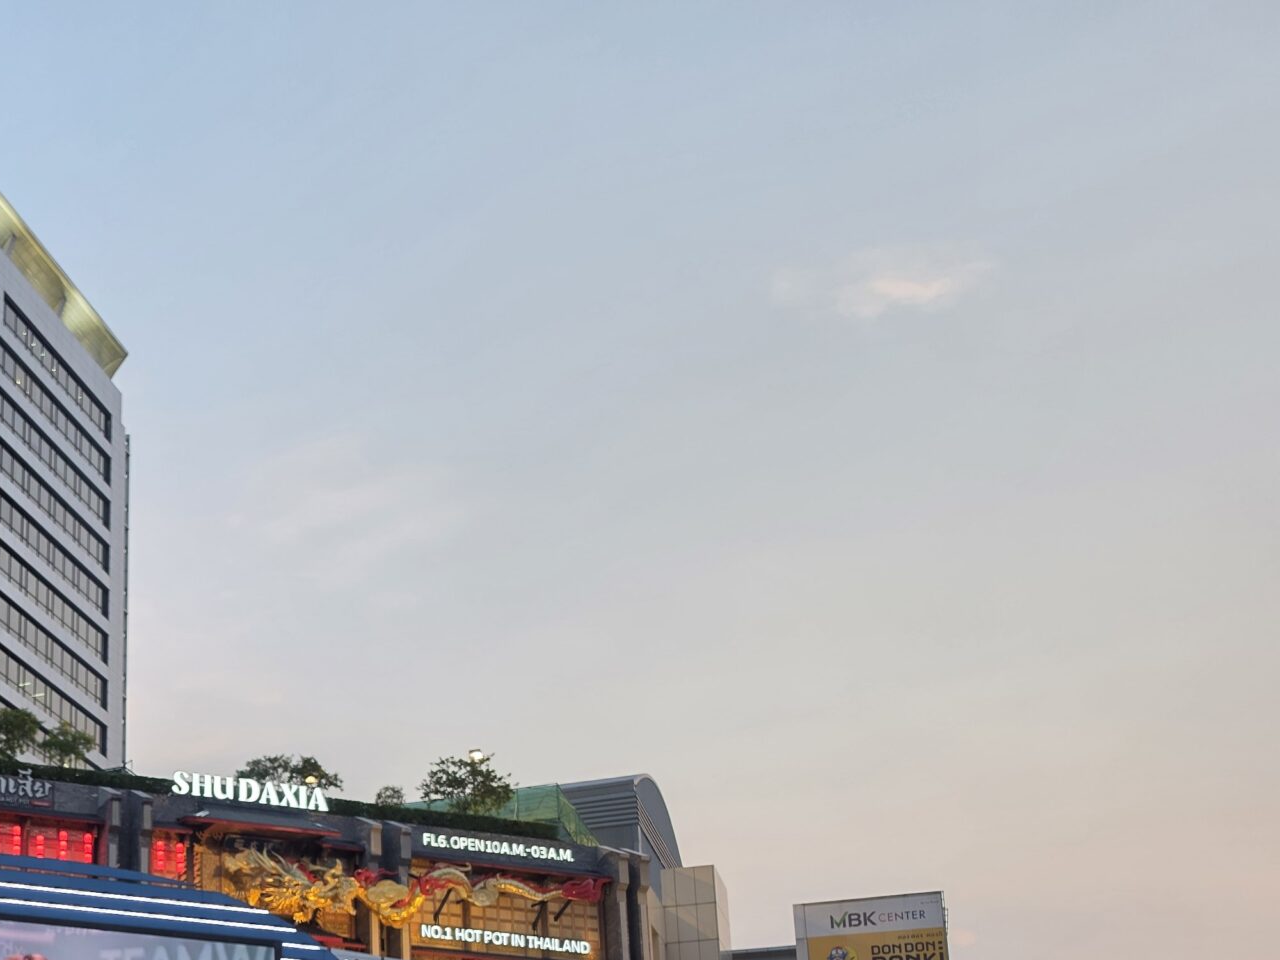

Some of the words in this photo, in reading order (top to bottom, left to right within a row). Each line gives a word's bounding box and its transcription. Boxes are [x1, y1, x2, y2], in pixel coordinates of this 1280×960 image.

[238, 777, 329, 811] DAXIA
[830, 911, 877, 929] MBK
[878, 909, 926, 923] CENTER
[455, 928, 481, 943] HOT
[483, 930, 510, 945] POT
[511, 932, 526, 947] IN
[527, 936, 591, 955] THAILAND
